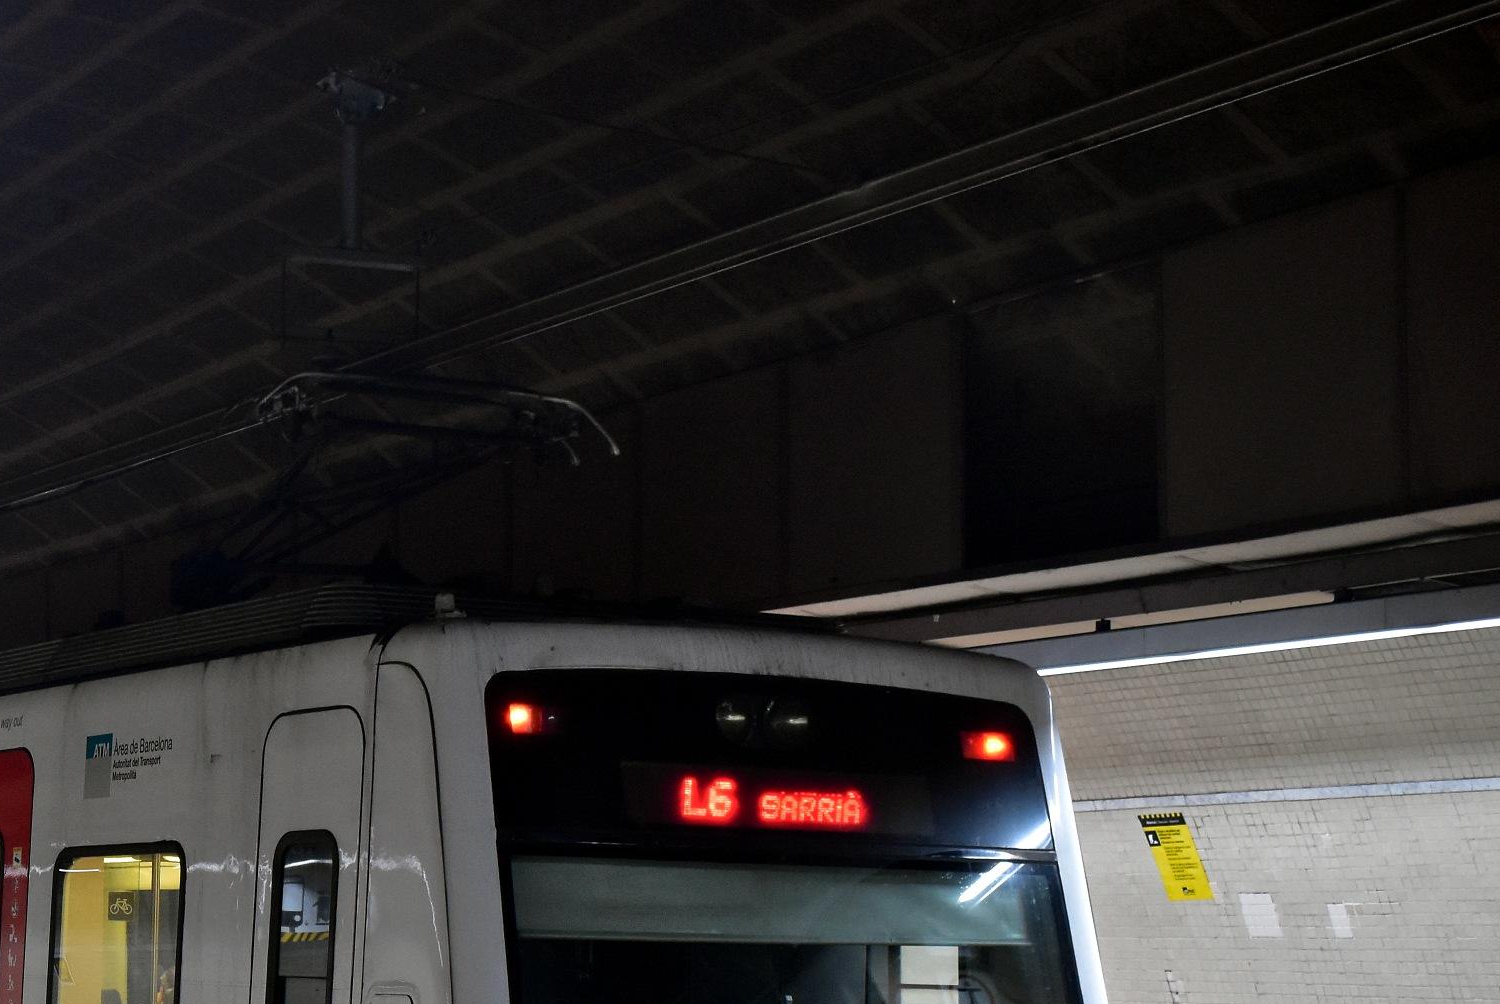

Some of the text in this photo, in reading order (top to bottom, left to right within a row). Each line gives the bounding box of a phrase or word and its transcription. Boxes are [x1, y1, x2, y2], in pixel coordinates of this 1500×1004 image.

[0, 718, 12, 731] way
[13, 715, 24, 728] out
[93, 742, 111, 759] ATM
[129, 739, 139, 756] de
[139, 736, 173, 754] Barcelona
[112, 755, 161, 770] Autoritat del Transport
[682, 778, 734, 818] L6
